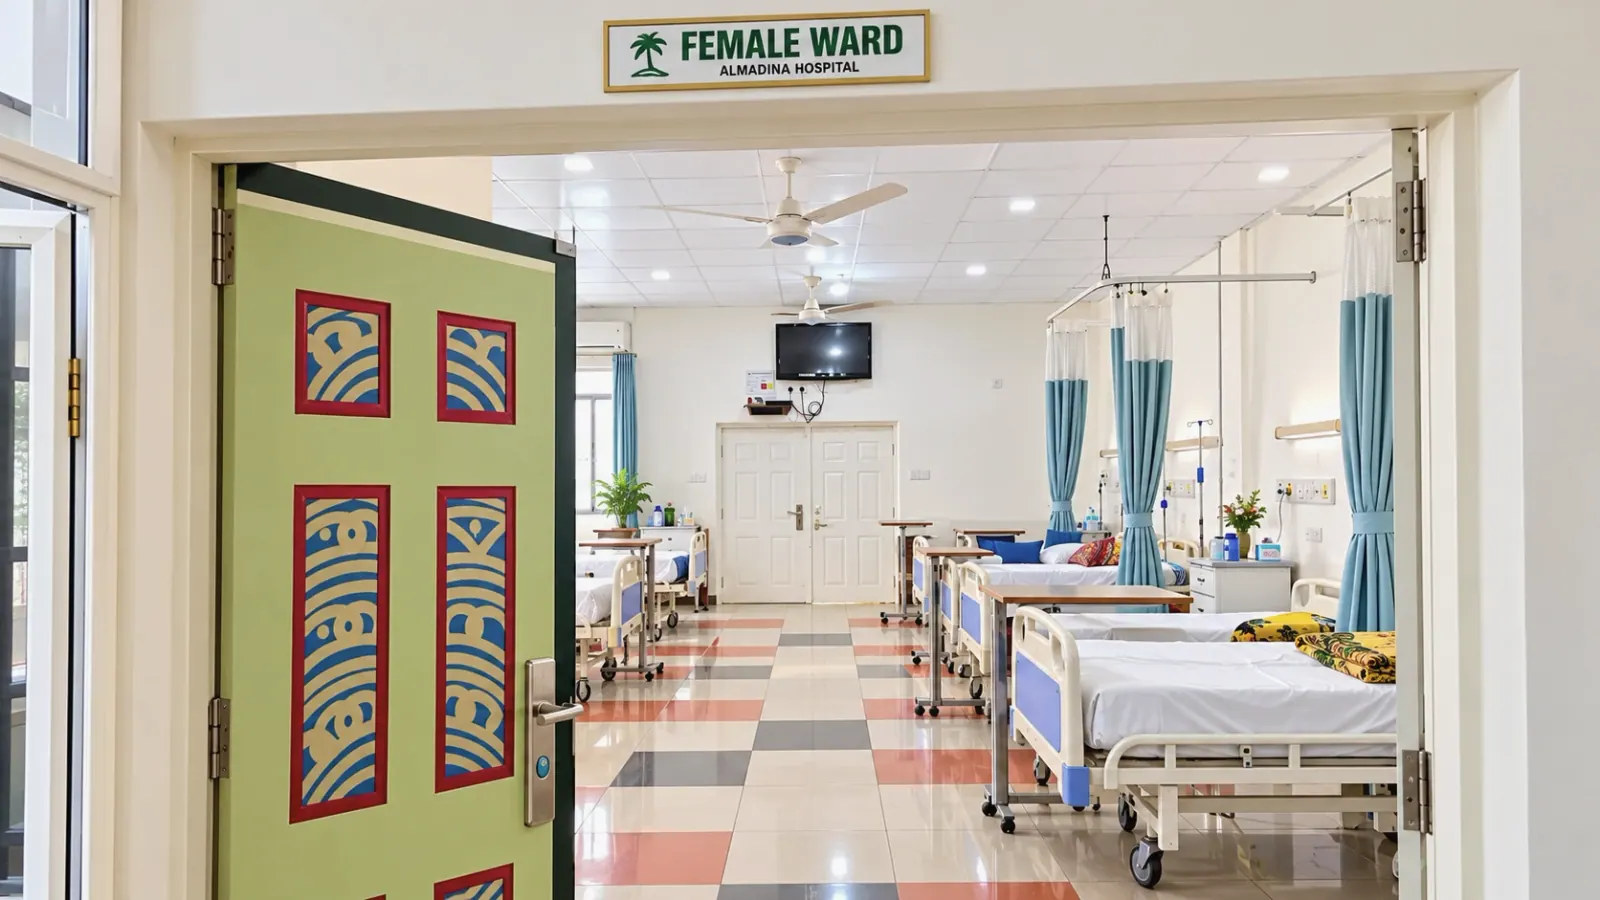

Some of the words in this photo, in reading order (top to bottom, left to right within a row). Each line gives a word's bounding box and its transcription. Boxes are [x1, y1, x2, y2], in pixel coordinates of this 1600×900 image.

[681, 28, 800, 61] FEMALE
[809, 24, 903, 57] WARD
[719, 63, 791, 77] ALMADINA
[795, 61, 860, 75] HOSPITAL
